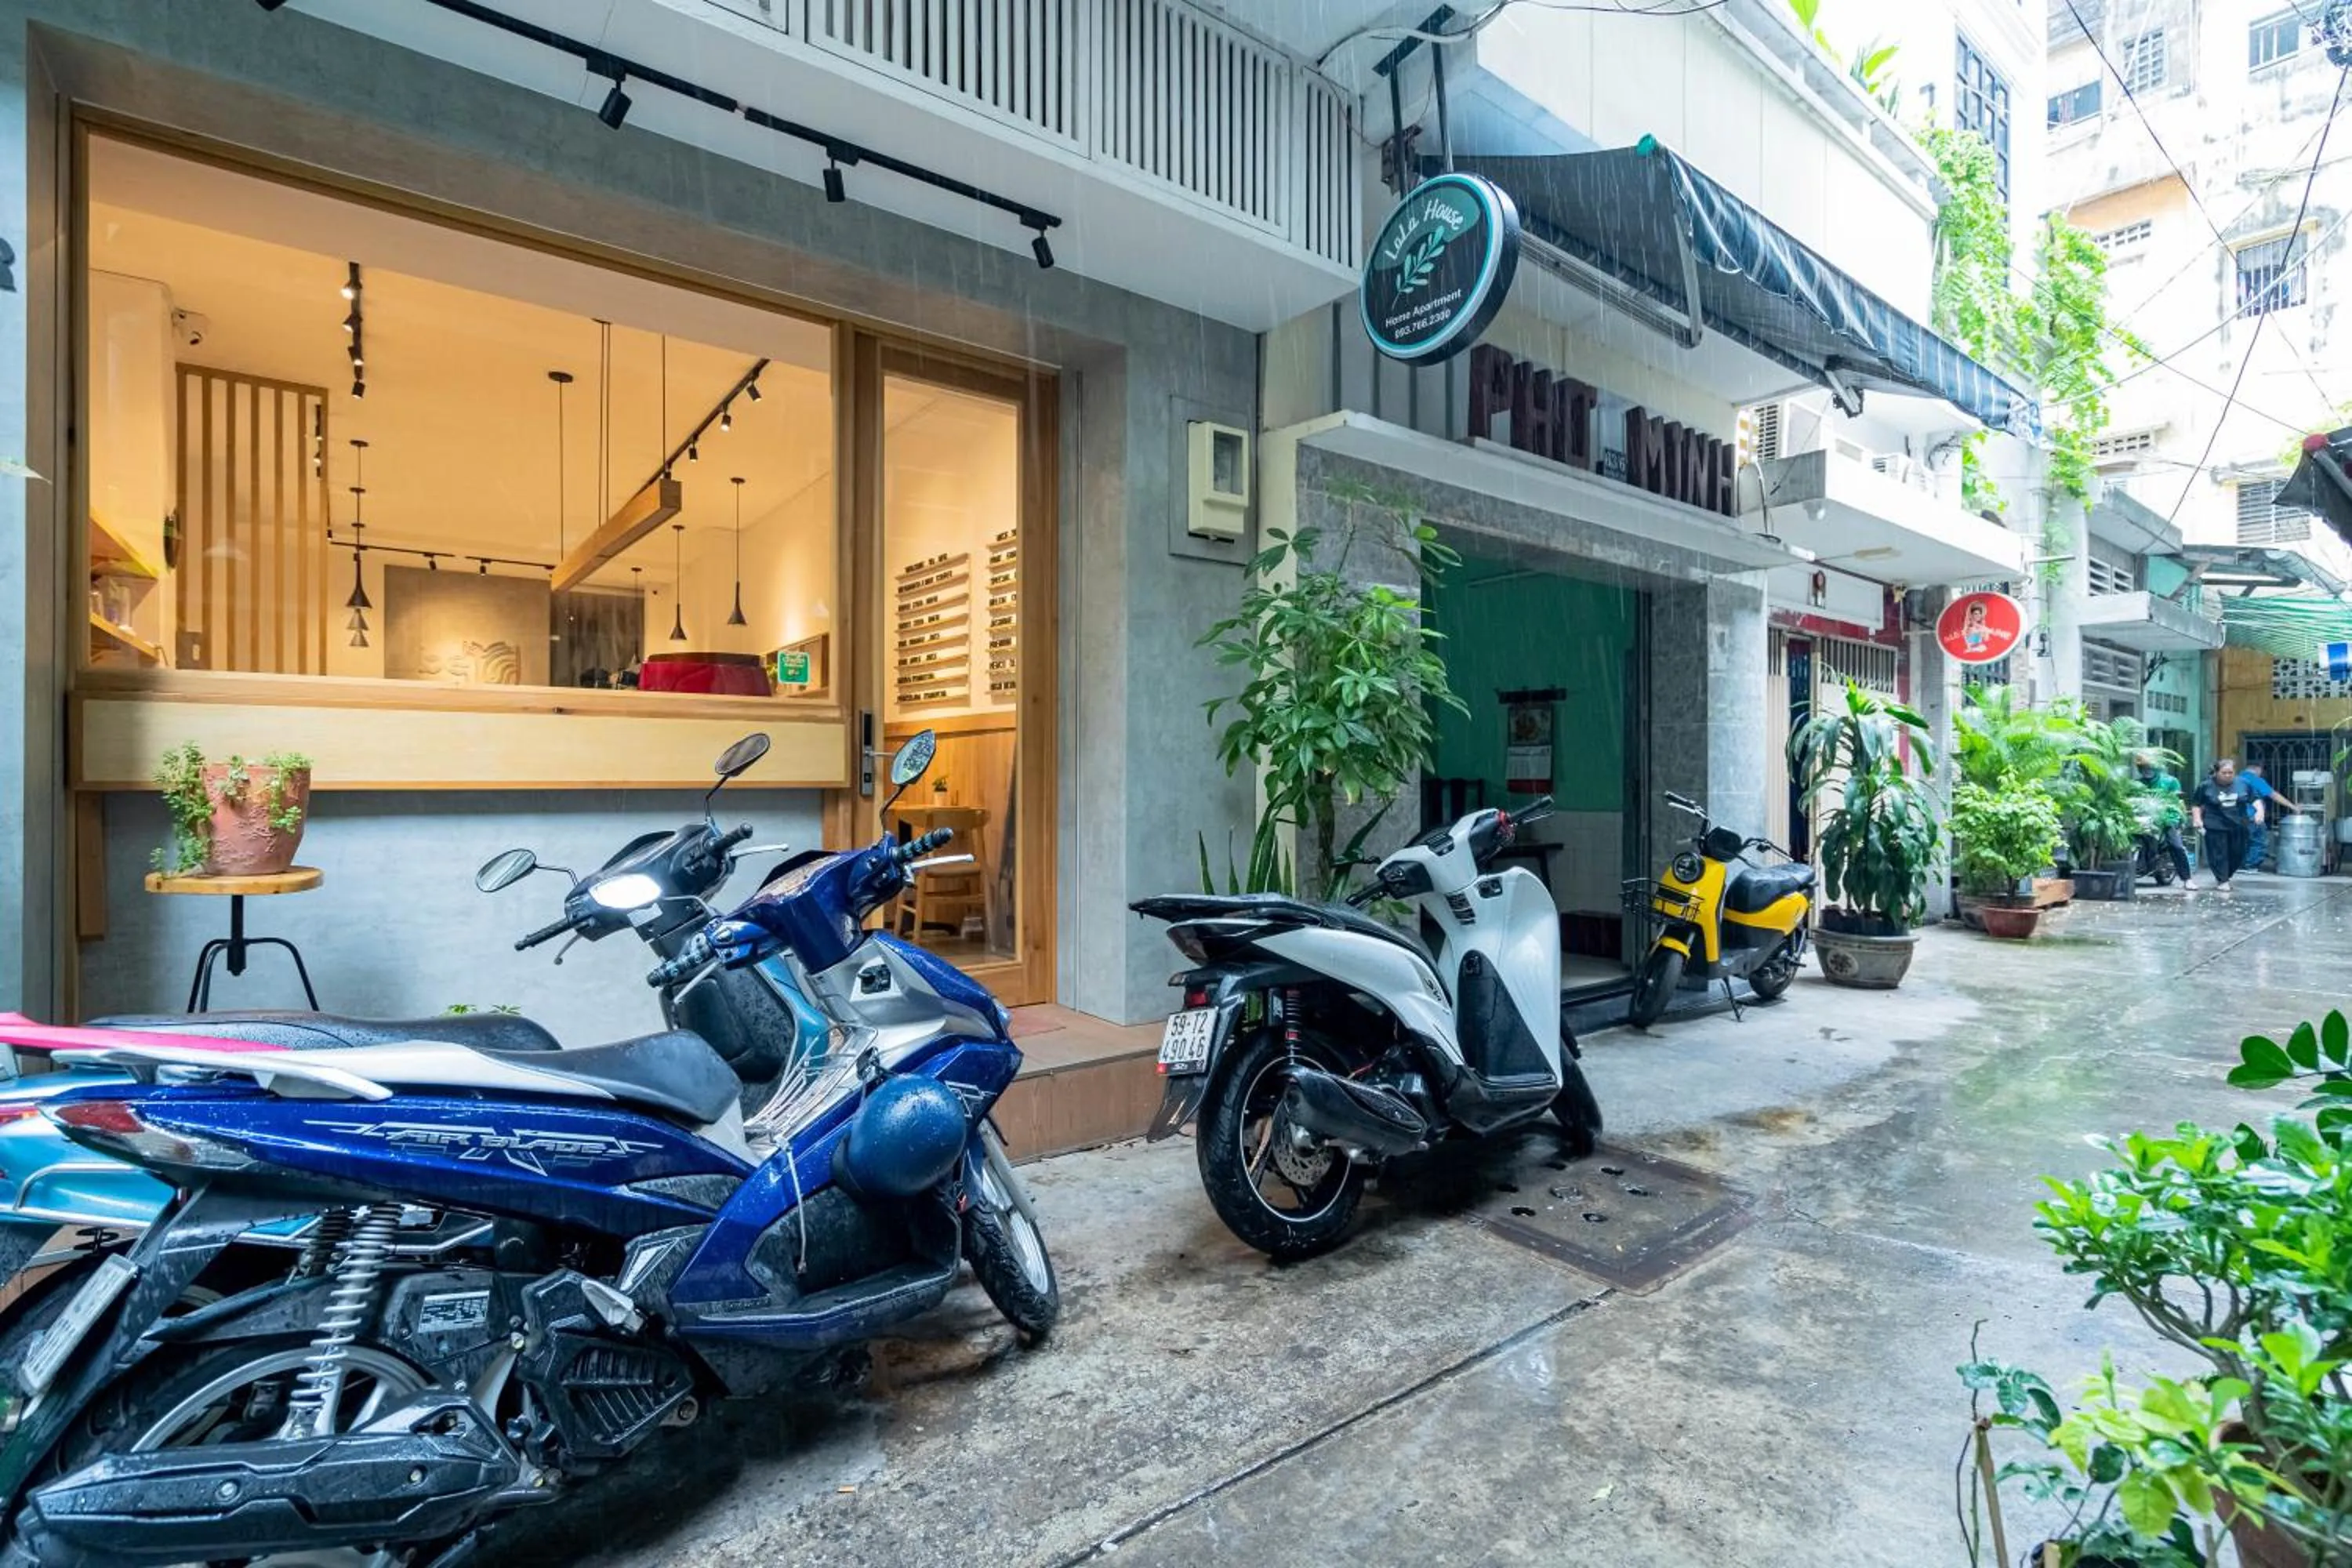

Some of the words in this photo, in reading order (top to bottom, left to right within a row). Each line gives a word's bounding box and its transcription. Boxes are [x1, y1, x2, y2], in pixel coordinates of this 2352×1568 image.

[1423, 198, 1464, 230] House
[1385, 311, 1412, 328] Home
[1413, 288, 1461, 318] Apartment
[1626, 405, 1738, 517] MINH
[385, 1130, 472, 1145] AIR
[480, 1134, 607, 1153] BLADE
